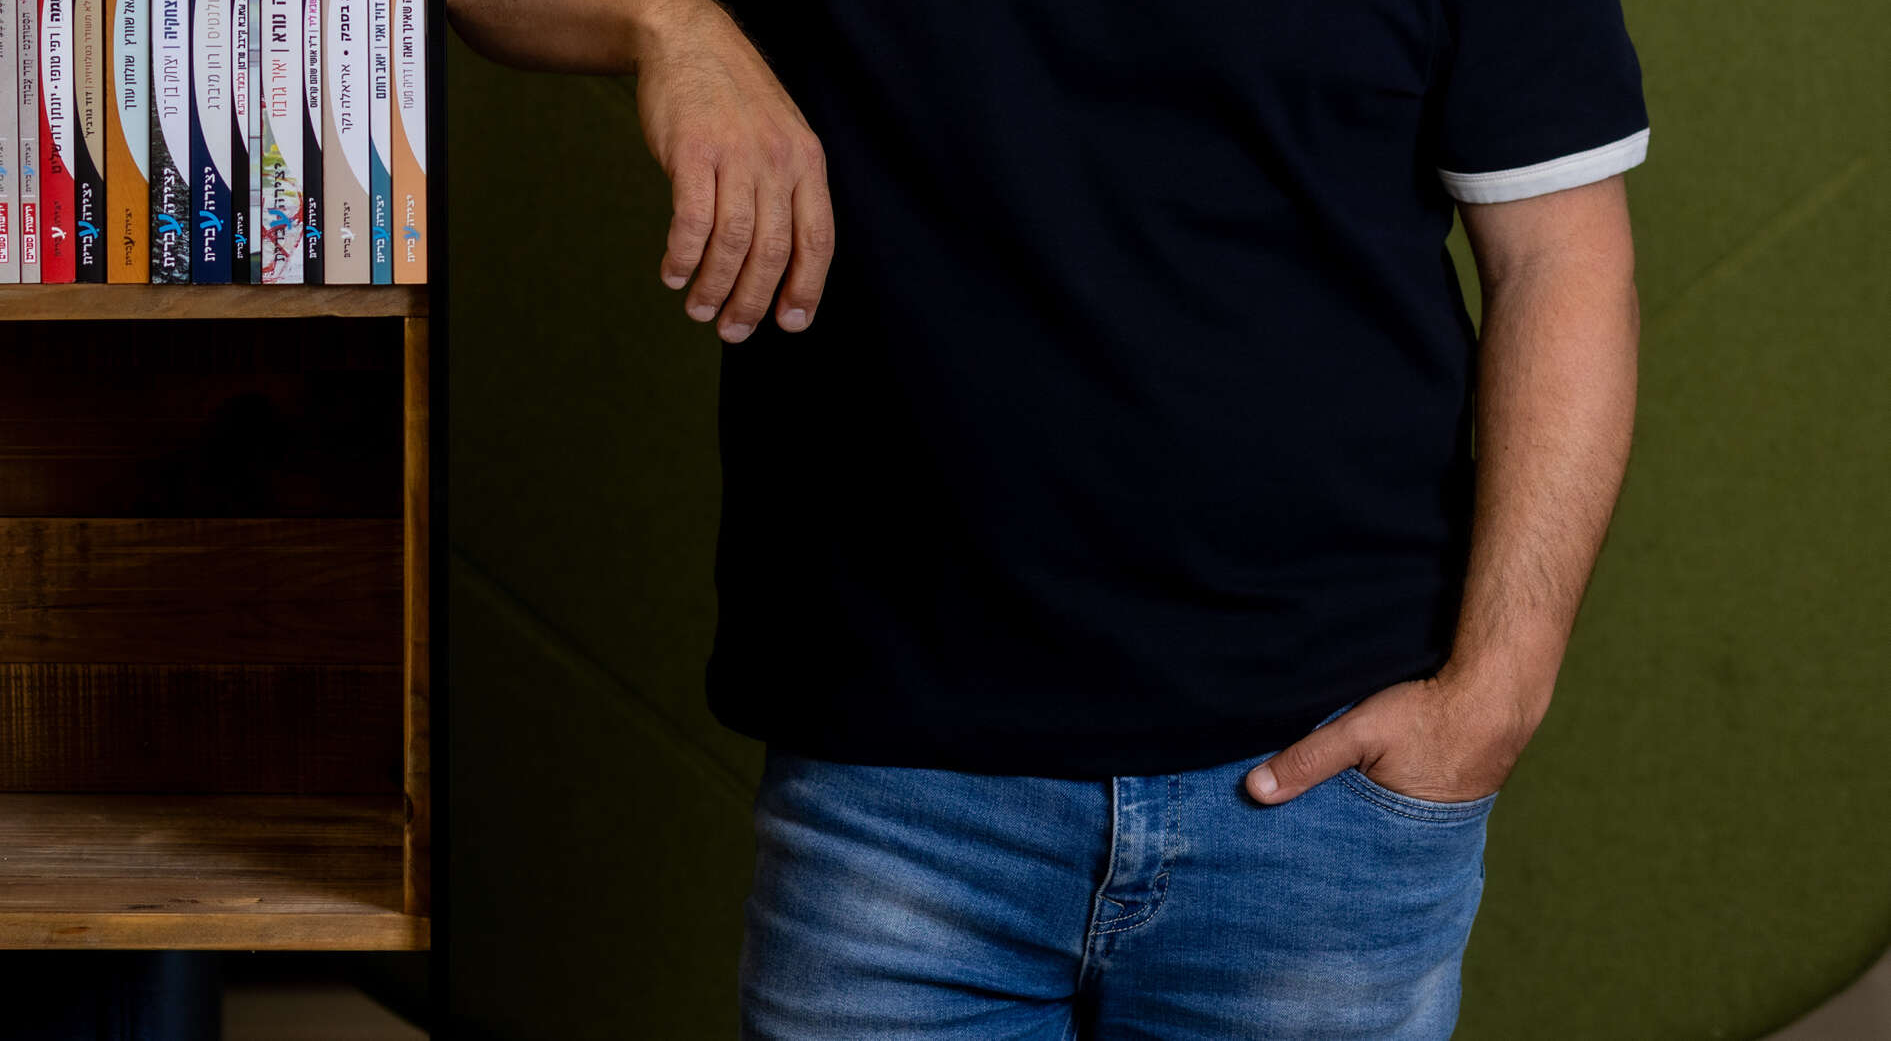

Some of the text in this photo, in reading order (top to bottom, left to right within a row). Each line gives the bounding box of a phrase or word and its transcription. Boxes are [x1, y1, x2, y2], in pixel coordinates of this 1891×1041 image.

[83, 0, 92, 12] לא
[237, 3, 245, 27] שאבא
[271, 14, 286, 42] נורא
[308, 15, 317, 27] ליד
[340, 5, 352, 41] בספק
[402, 6, 414, 31] שאינך
[50, 33, 61, 52] רפי
[124, 17, 137, 45] שוורץ
[237, 29, 247, 49] קיבל
[309, 50, 317, 66] אושי
[375, 2, 386, 99] דויד ואני יואב רותם
[402, 36, 413, 58] רואה
[50, 56, 61, 81] טופז
[123, 55, 137, 85] שולחן
[163, 55, 180, 82] יצחק
[207, 53, 222, 69] רון
[272, 59, 287, 82] יאיר
[207, 74, 221, 110] מיברג
[339, 64, 351, 108] אריאלה
[50, 93, 64, 120] יונתן
[85, 91, 93, 106] דוד
[124, 88, 137, 111] עורך
[272, 87, 287, 118] גרבוז
[51, 125, 61, 139] דה
[341, 113, 353, 133] נקר
[50, 142, 62, 174] שליט
